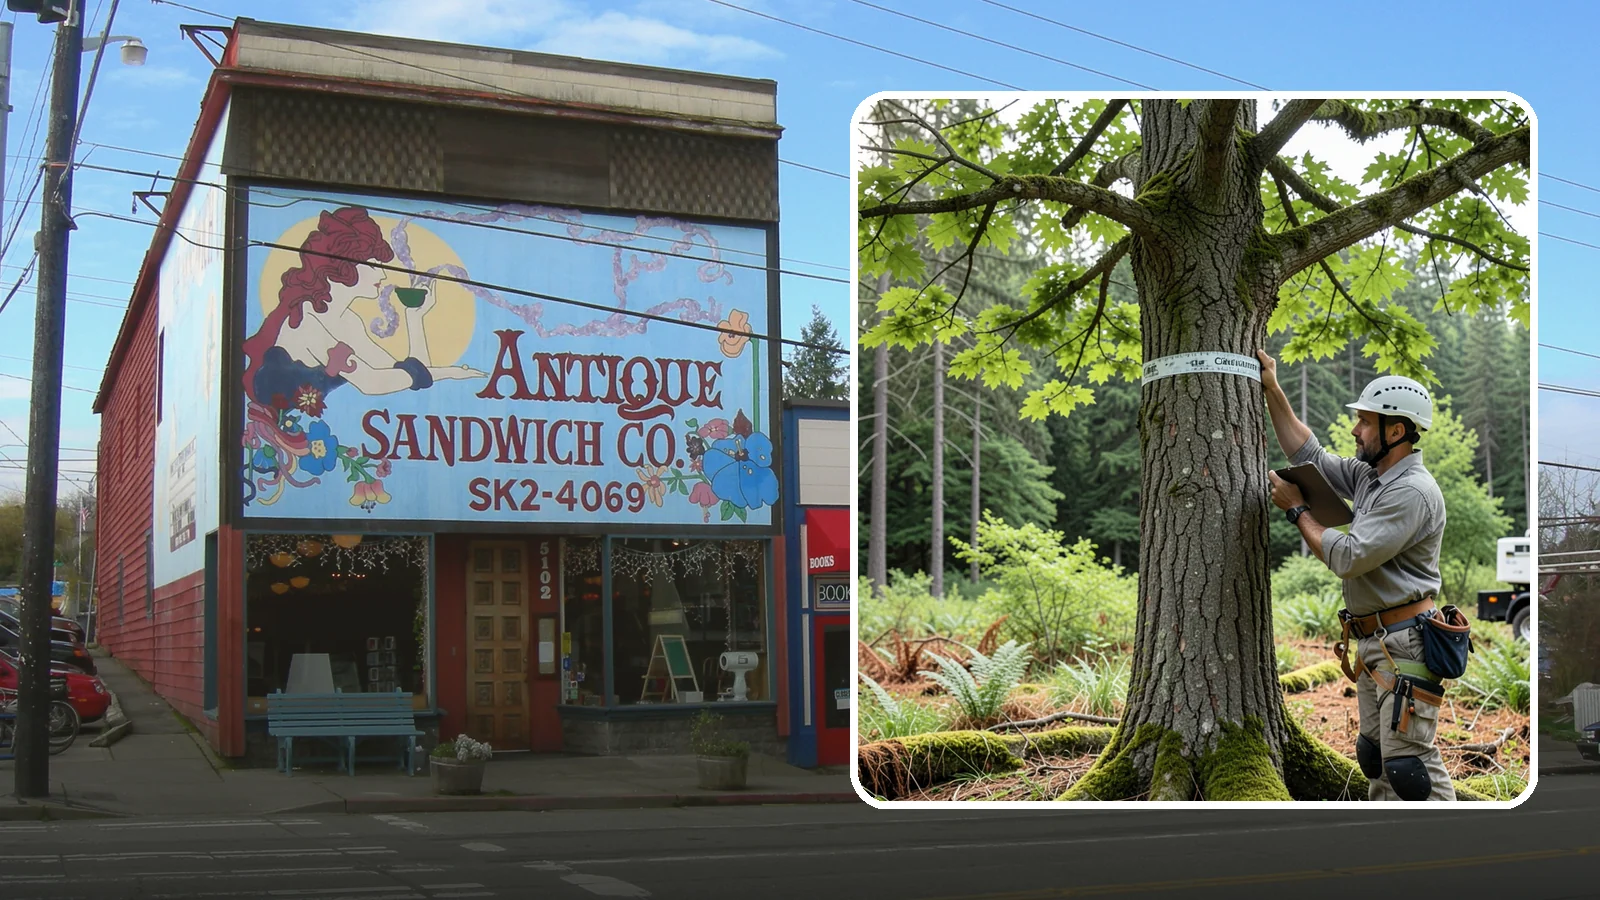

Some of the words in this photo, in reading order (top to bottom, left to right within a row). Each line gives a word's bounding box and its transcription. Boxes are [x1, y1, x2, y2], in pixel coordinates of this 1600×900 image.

[475, 329, 724, 421] ANTIQUE
[361, 408, 605, 467] SANDWICH
[616, 421, 686, 469] CO.
[468, 476, 646, 514] SK2-4069
[539, 542, 551, 600] 5102
[809, 555, 834, 568] BOOKS
